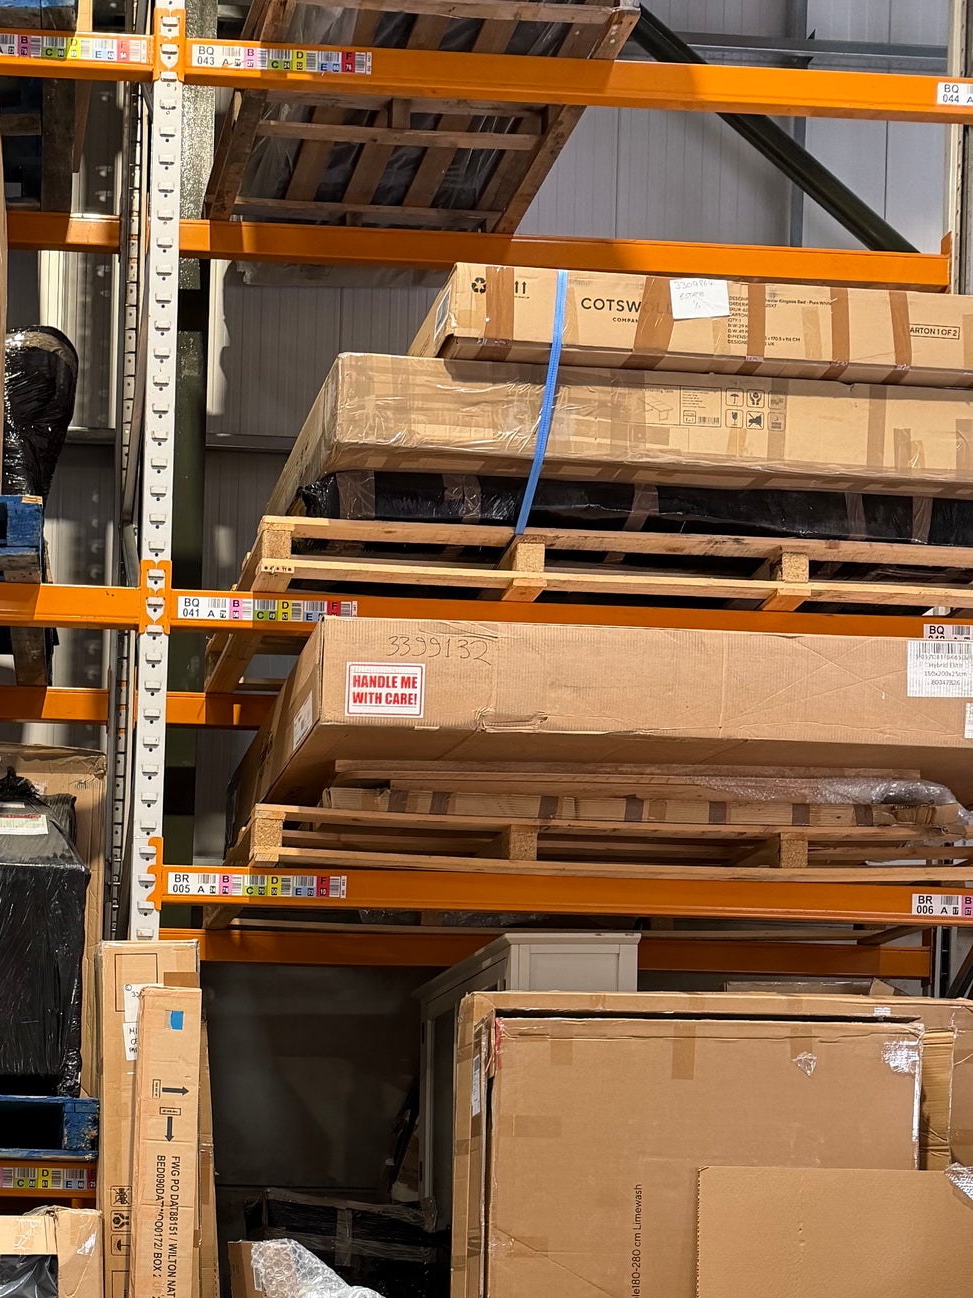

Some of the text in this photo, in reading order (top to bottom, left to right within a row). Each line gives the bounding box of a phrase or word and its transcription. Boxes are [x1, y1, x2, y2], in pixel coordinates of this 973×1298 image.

[21, 36, 28, 44] B
[45, 48, 53, 56] C
[95, 50, 102, 58] E
[198, 46, 352, 60] BQ B D F
[197, 56, 327, 71] 043 A C E
[944, 84, 959, 93] BQ
[942, 94, 960, 103] 044
[910, 327, 936, 336] ARTON
[184, 598, 200, 607] BQ
[282, 601, 289, 609] D
[332, 601, 338, 609] F
[183, 608, 313, 621] 041 A C E
[929, 626, 945, 635] BQ
[387, 636, 492, 665] 3399132
[352, 675, 418, 689] HANDLE ME
[352, 692, 417, 705] WITH CARE!
[175, 874, 189, 883] BR
[223, 875, 229, 883] B
[173, 884, 190, 893] 005
[918, 895, 932, 904] BR
[917, 905, 933, 914] 006
[171, 1156, 180, 1176] FWG
[170, 1180, 179, 1192] PO
[632, 1184, 643, 1230] Limewash
[168, 1195, 179, 1235] DAT88151
[634, 1232, 642, 1247] cm
[152, 1253, 162, 1272] BOX
[167, 1243, 177, 1278] WILTON
